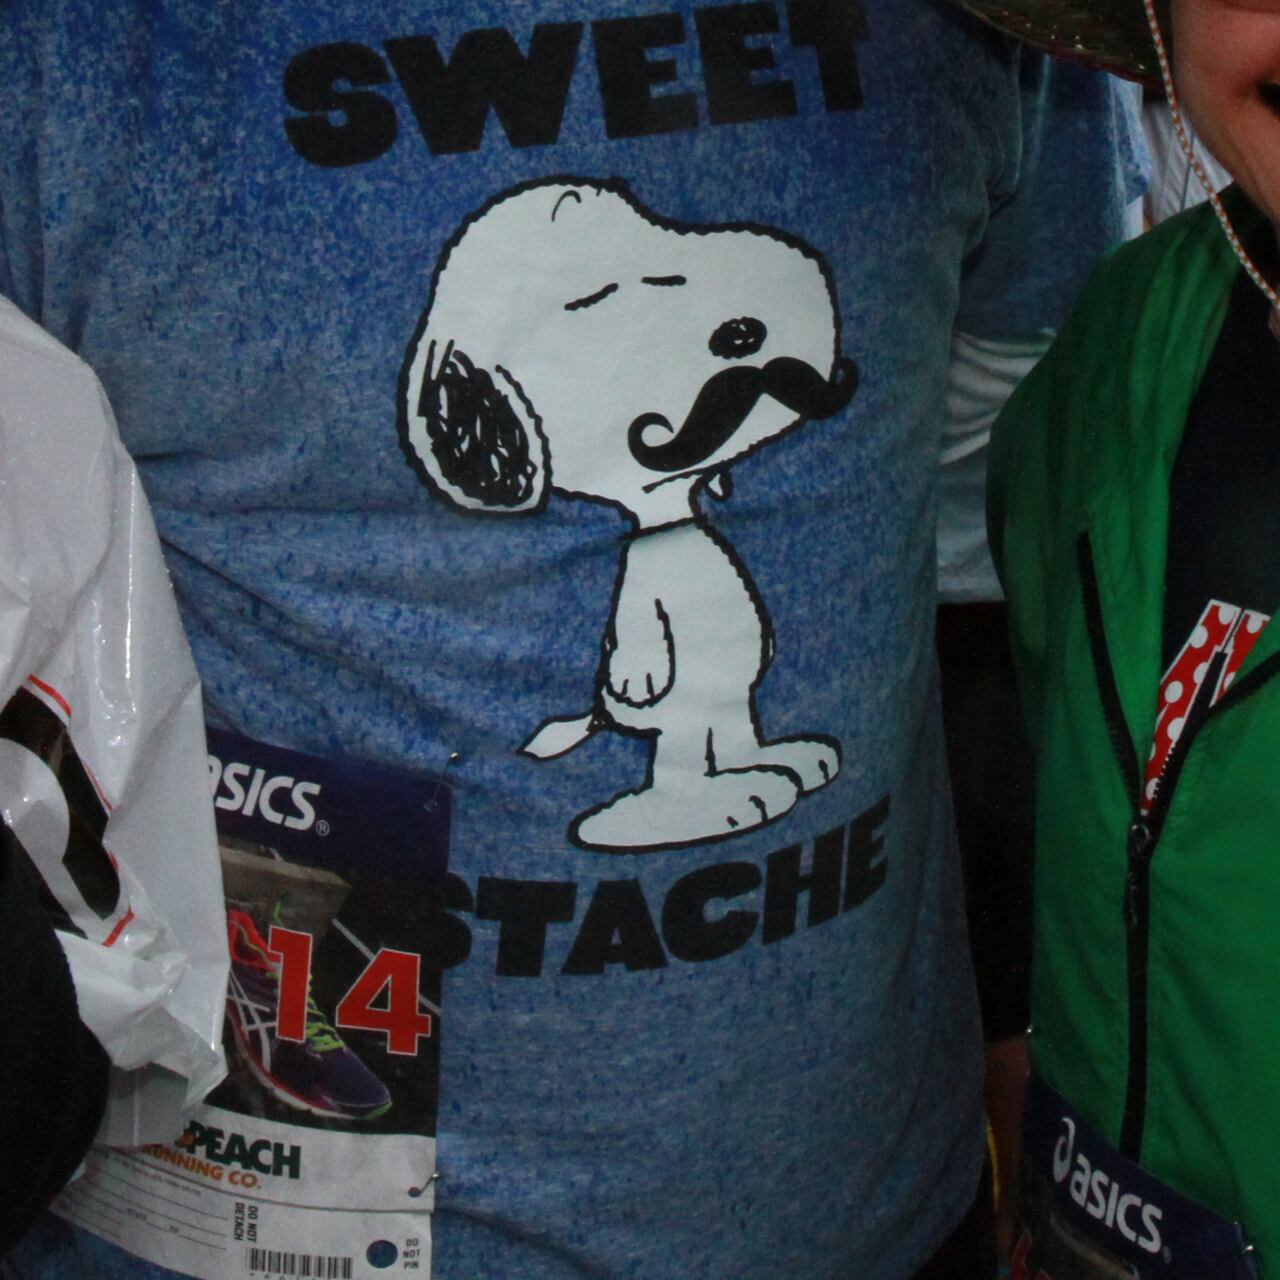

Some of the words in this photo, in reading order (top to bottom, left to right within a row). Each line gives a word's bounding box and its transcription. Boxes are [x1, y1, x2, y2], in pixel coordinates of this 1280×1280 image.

[189, 1120, 301, 1179] PEACH
[248, 1205, 259, 1221] DO
[233, 1202, 245, 1241] DETACH
[246, 1224, 257, 1243] NOT
[406, 1238, 419, 1247] DO
[403, 1249, 420, 1259] NOT
[404, 1260, 419, 1269] PIN
